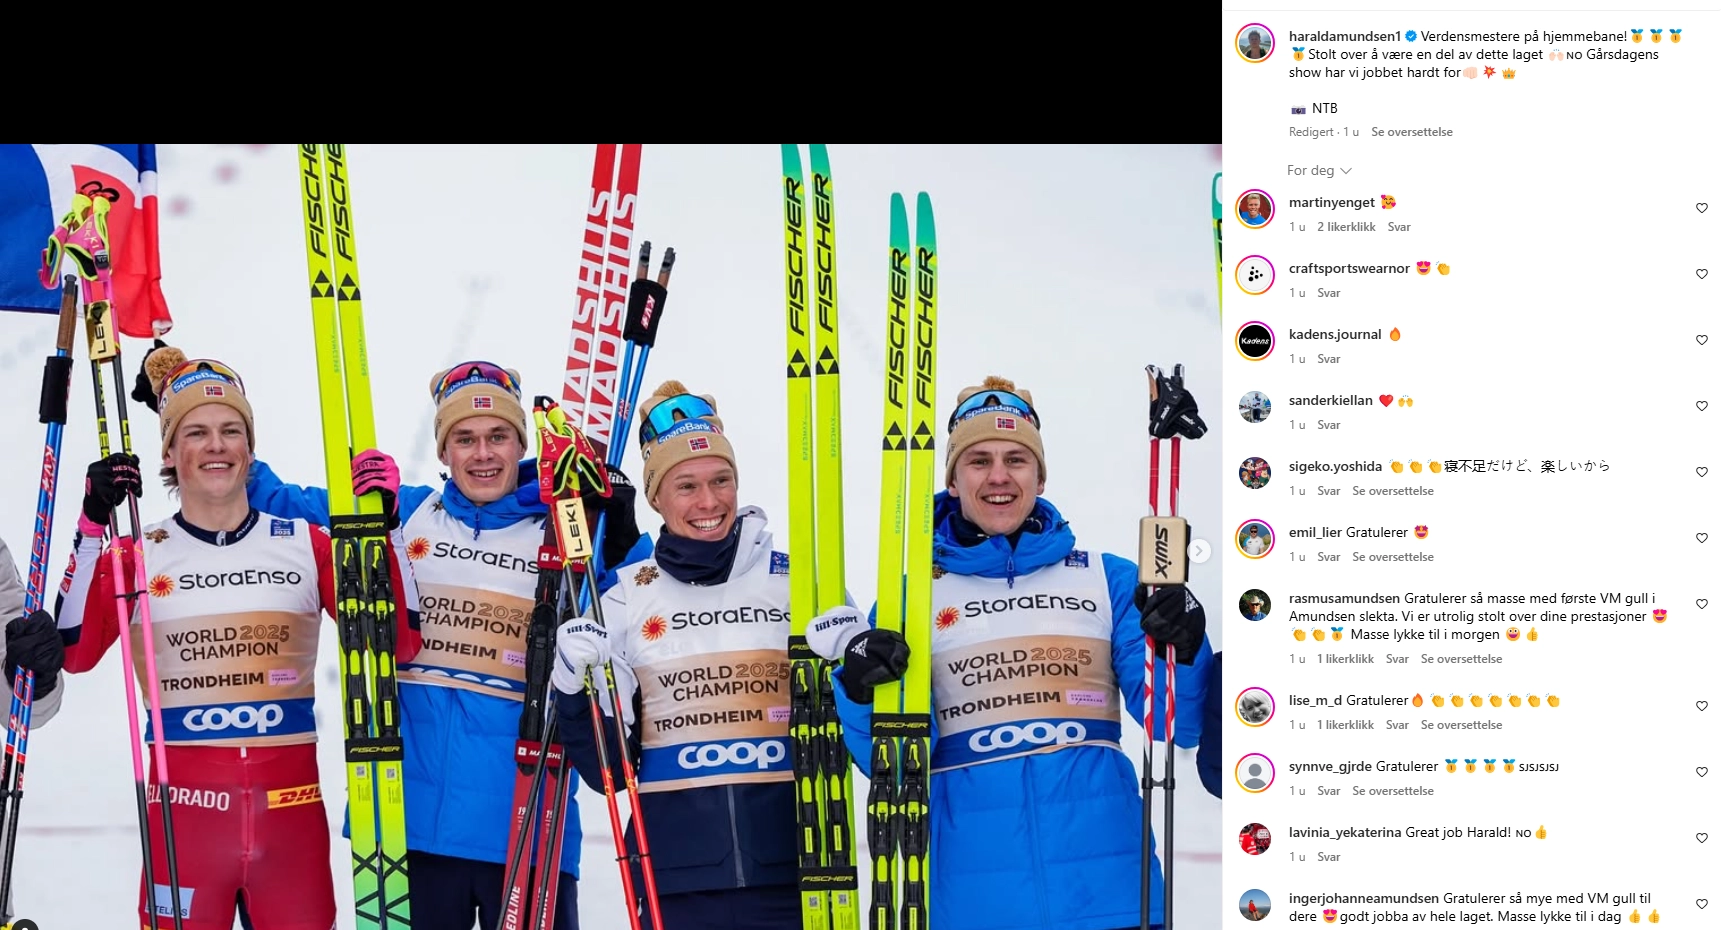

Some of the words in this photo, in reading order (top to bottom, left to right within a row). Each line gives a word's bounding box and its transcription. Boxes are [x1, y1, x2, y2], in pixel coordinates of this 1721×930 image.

[1289, 30, 1401, 42] haraldamundsen1
[1420, 30, 1521, 42] Verdensmestere
[1524, 29, 1539, 45] på
[1543, 30, 1627, 45] hjemmebane!
[1308, 48, 1337, 60] Stolt
[1340, 51, 1368, 60] over
[1370, 47, 1378, 60] å
[1381, 51, 1413, 60] være
[1416, 51, 1432, 60] en
[1435, 48, 1455, 60] del
[1458, 51, 1473, 60] av
[1475, 48, 1509, 60] dette
[1512, 48, 1544, 63] laget
[1586, 47, 1659, 63] Gårsdagens
[1288, 66, 1322, 78] show
[1325, 66, 1346, 78] har
[1348, 66, 1359, 78] vi
[1360, 66, 1404, 81] jobbet
[1407, 66, 1440, 78] hardt
[1443, 66, 1462, 78] for
[1312, 102, 1338, 114] NTB
[1289, 126, 1334, 140] Redigert
[1343, 126, 1348, 137] 1
[1352, 129, 1359, 137] u
[1371, 126, 1385, 137] Se
[1387, 126, 1454, 137] oversettelse
[1287, 164, 1308, 176] For
[1310, 164, 1335, 179] deg
[301, 145, 327, 258] FISCH
[327, 145, 353, 261] FISCH
[1289, 196, 1376, 211] martinyenget
[785, 177, 804, 336] FISCHER
[814, 173, 833, 333] FISCHER
[1288, 262, 1411, 277] craftsportswearnor
[587, 189, 638, 444] MADSHUS
[888, 247, 907, 409] FISCHER
[916, 246, 934, 408] FISCHER
[1289, 328, 1382, 343] kadens.journal
[1241, 337, 1270, 345] Kadens
[1288, 394, 1373, 406] sanderkiellan
[658, 422, 711, 444] SpareBank
[1288, 460, 1383, 475] sigeko.yoshida
[1443, 458, 1610, 474] 寝不足だけど、楽しいから
[333, 521, 385, 530] FISCHER
[565, 503, 583, 552] LEKI
[1288, 526, 1343, 540] emil_lier
[1345, 526, 1409, 538] Gratulerer
[433, 542, 540, 574] StoraEns
[179, 569, 302, 590] StoraEnso
[964, 594, 1097, 618] StoraEnso
[1289, 592, 1401, 604] rasmusamundsen
[1404, 592, 1468, 604] Gratulerer
[1470, 591, 1483, 604] så
[1487, 595, 1526, 604] masse
[1529, 592, 1557, 604] med
[1560, 592, 1597, 605] første
[1599, 592, 1621, 604] VM
[1624, 592, 1648, 607] gull
[1652, 592, 1656, 604] i
[419, 611, 521, 638] CHAMPION
[1288, 610, 1356, 622] Amundsen
[1359, 610, 1398, 622] slekta.
[1401, 610, 1414, 622] Vi
[1417, 613, 1431, 622] er
[1433, 610, 1474, 625] utrolig
[1477, 610, 1506, 622] stolt
[1508, 613, 1537, 622] over
[1539, 610, 1568, 622] dine
[1570, 610, 1648, 625] prestasjoner
[166, 627, 238, 648] WORLD
[240, 625, 290, 643] 2025
[1351, 628, 1390, 640] Masse
[1393, 628, 1425, 643] lykke
[1428, 628, 1440, 640] til
[1444, 628, 1447, 640] i
[1451, 631, 1500, 643] morgen
[180, 641, 279, 662] CHAMPION
[421, 638, 497, 660] NDHEIM
[948, 649, 1028, 675] WORLD
[1030, 647, 1093, 666] 2025
[161, 672, 264, 692] TRONDHEIM
[658, 665, 733, 688] WORLD
[735, 662, 791, 680] 2025
[961, 663, 1079, 687] CHAMPION
[673, 680, 779, 702] CHAMPION
[1289, 694, 1343, 708] lise_m_d
[1346, 694, 1410, 706] Gratulerer
[940, 691, 1061, 721] TRONDHEIM
[182, 703, 284, 734] coop
[654, 709, 763, 733] TRONDHEIM
[873, 721, 929, 729] FISCHER
[968, 720, 1087, 753] coop
[350, 745, 400, 754] FISCHER
[677, 739, 786, 770] coop
[1288, 760, 1373, 775] synnve_gjrde
[1375, 760, 1439, 772] Gratulerer
[1289, 826, 1402, 841] lavinia_yekaterina
[1405, 826, 1440, 838] Great
[1440, 826, 1463, 841] job
[1467, 826, 1511, 838] Harald!
[506, 886, 521, 930] EDLINE
[1289, 892, 1440, 907] ingerjohanneamundsen
[1443, 892, 1507, 904] Gratulerer
[1509, 891, 1522, 904] så
[1526, 895, 1553, 907] mye
[1556, 892, 1584, 904] med
[1587, 892, 1609, 904] VM
[1612, 892, 1636, 907] gull
[1638, 892, 1651, 904] til
[1288, 910, 1318, 922] dere
[1339, 910, 1370, 925] godt
[1370, 910, 1409, 925] jobba
[1411, 913, 1427, 922] av
[1430, 910, 1457, 922] hele
[1459, 910, 1494, 925] laget.
[1497, 910, 1537, 922] Masse
[1540, 910, 1572, 925] lykke
[1574, 910, 1587, 922] til
[1590, 910, 1594, 922] i
[1597, 910, 1622, 925] dag
